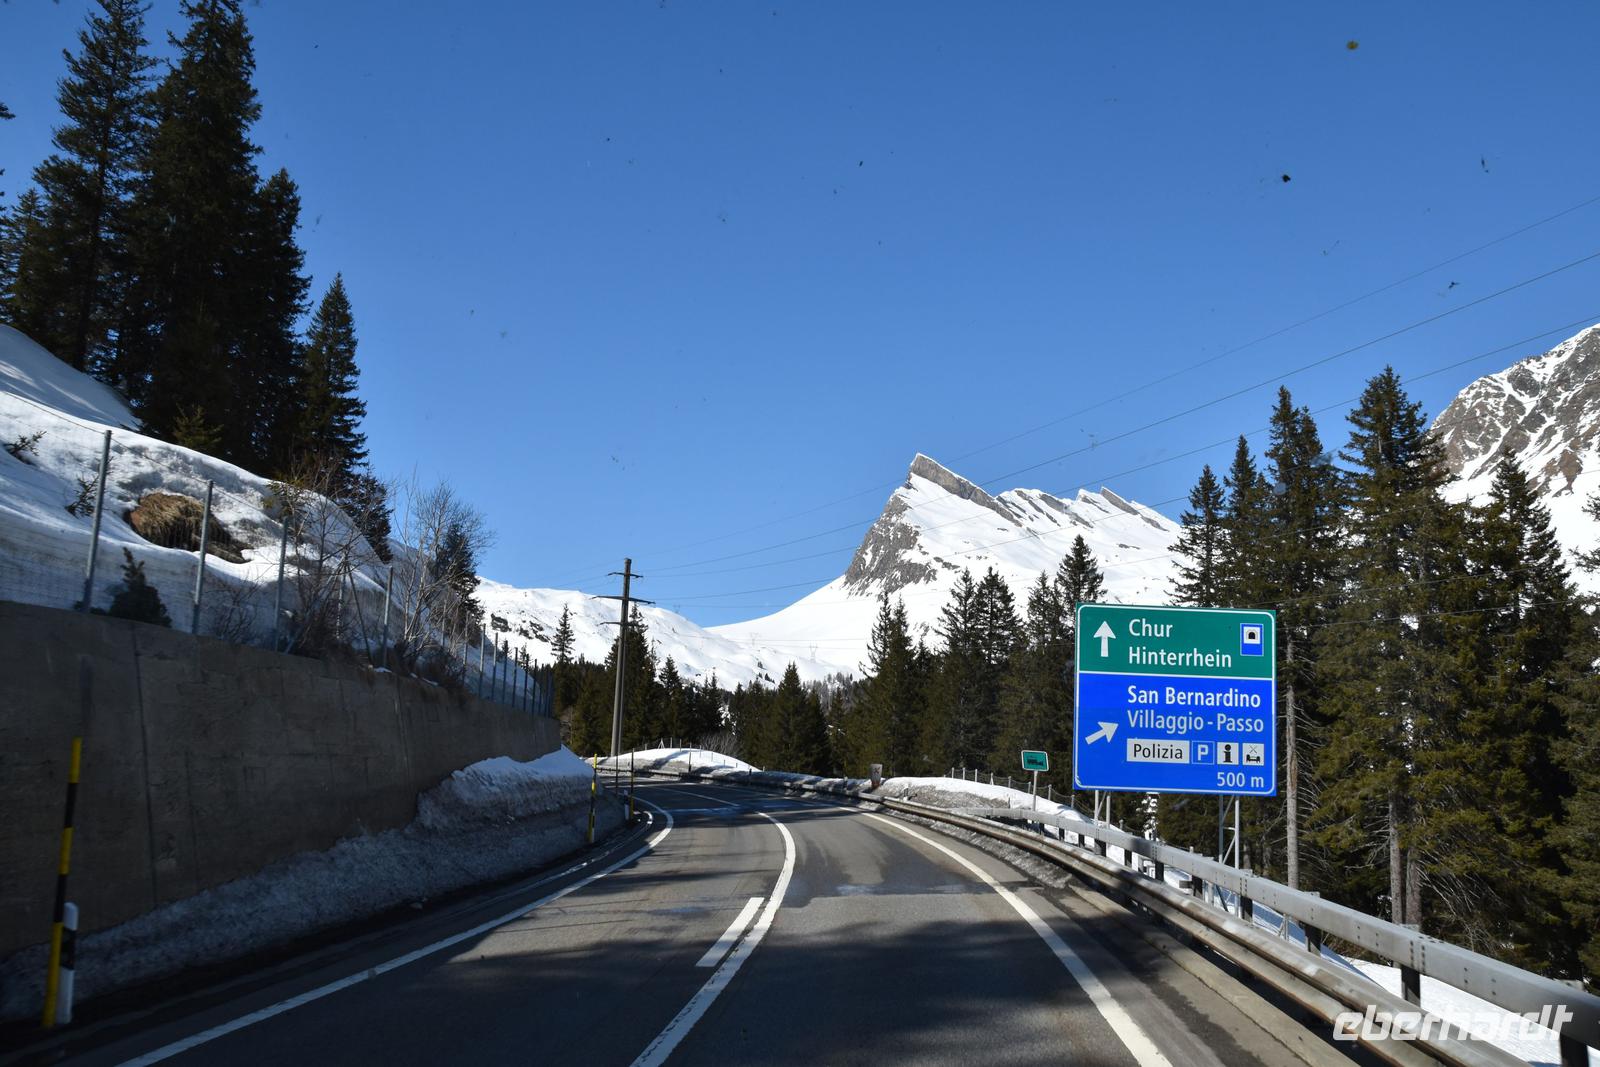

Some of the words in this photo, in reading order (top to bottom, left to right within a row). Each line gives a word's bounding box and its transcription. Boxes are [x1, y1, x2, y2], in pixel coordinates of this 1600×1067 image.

[1128, 618, 1173, 638] Chur
[1128, 646, 1232, 668] Hinterrhein
[1127, 685, 1159, 704] San
[1165, 686, 1261, 708] Bernardino
[1133, 743, 1183, 760] Polizia
[1197, 744, 1209, 761] P
[1216, 771, 1246, 788] 500
[1250, 775, 1265, 788] m
